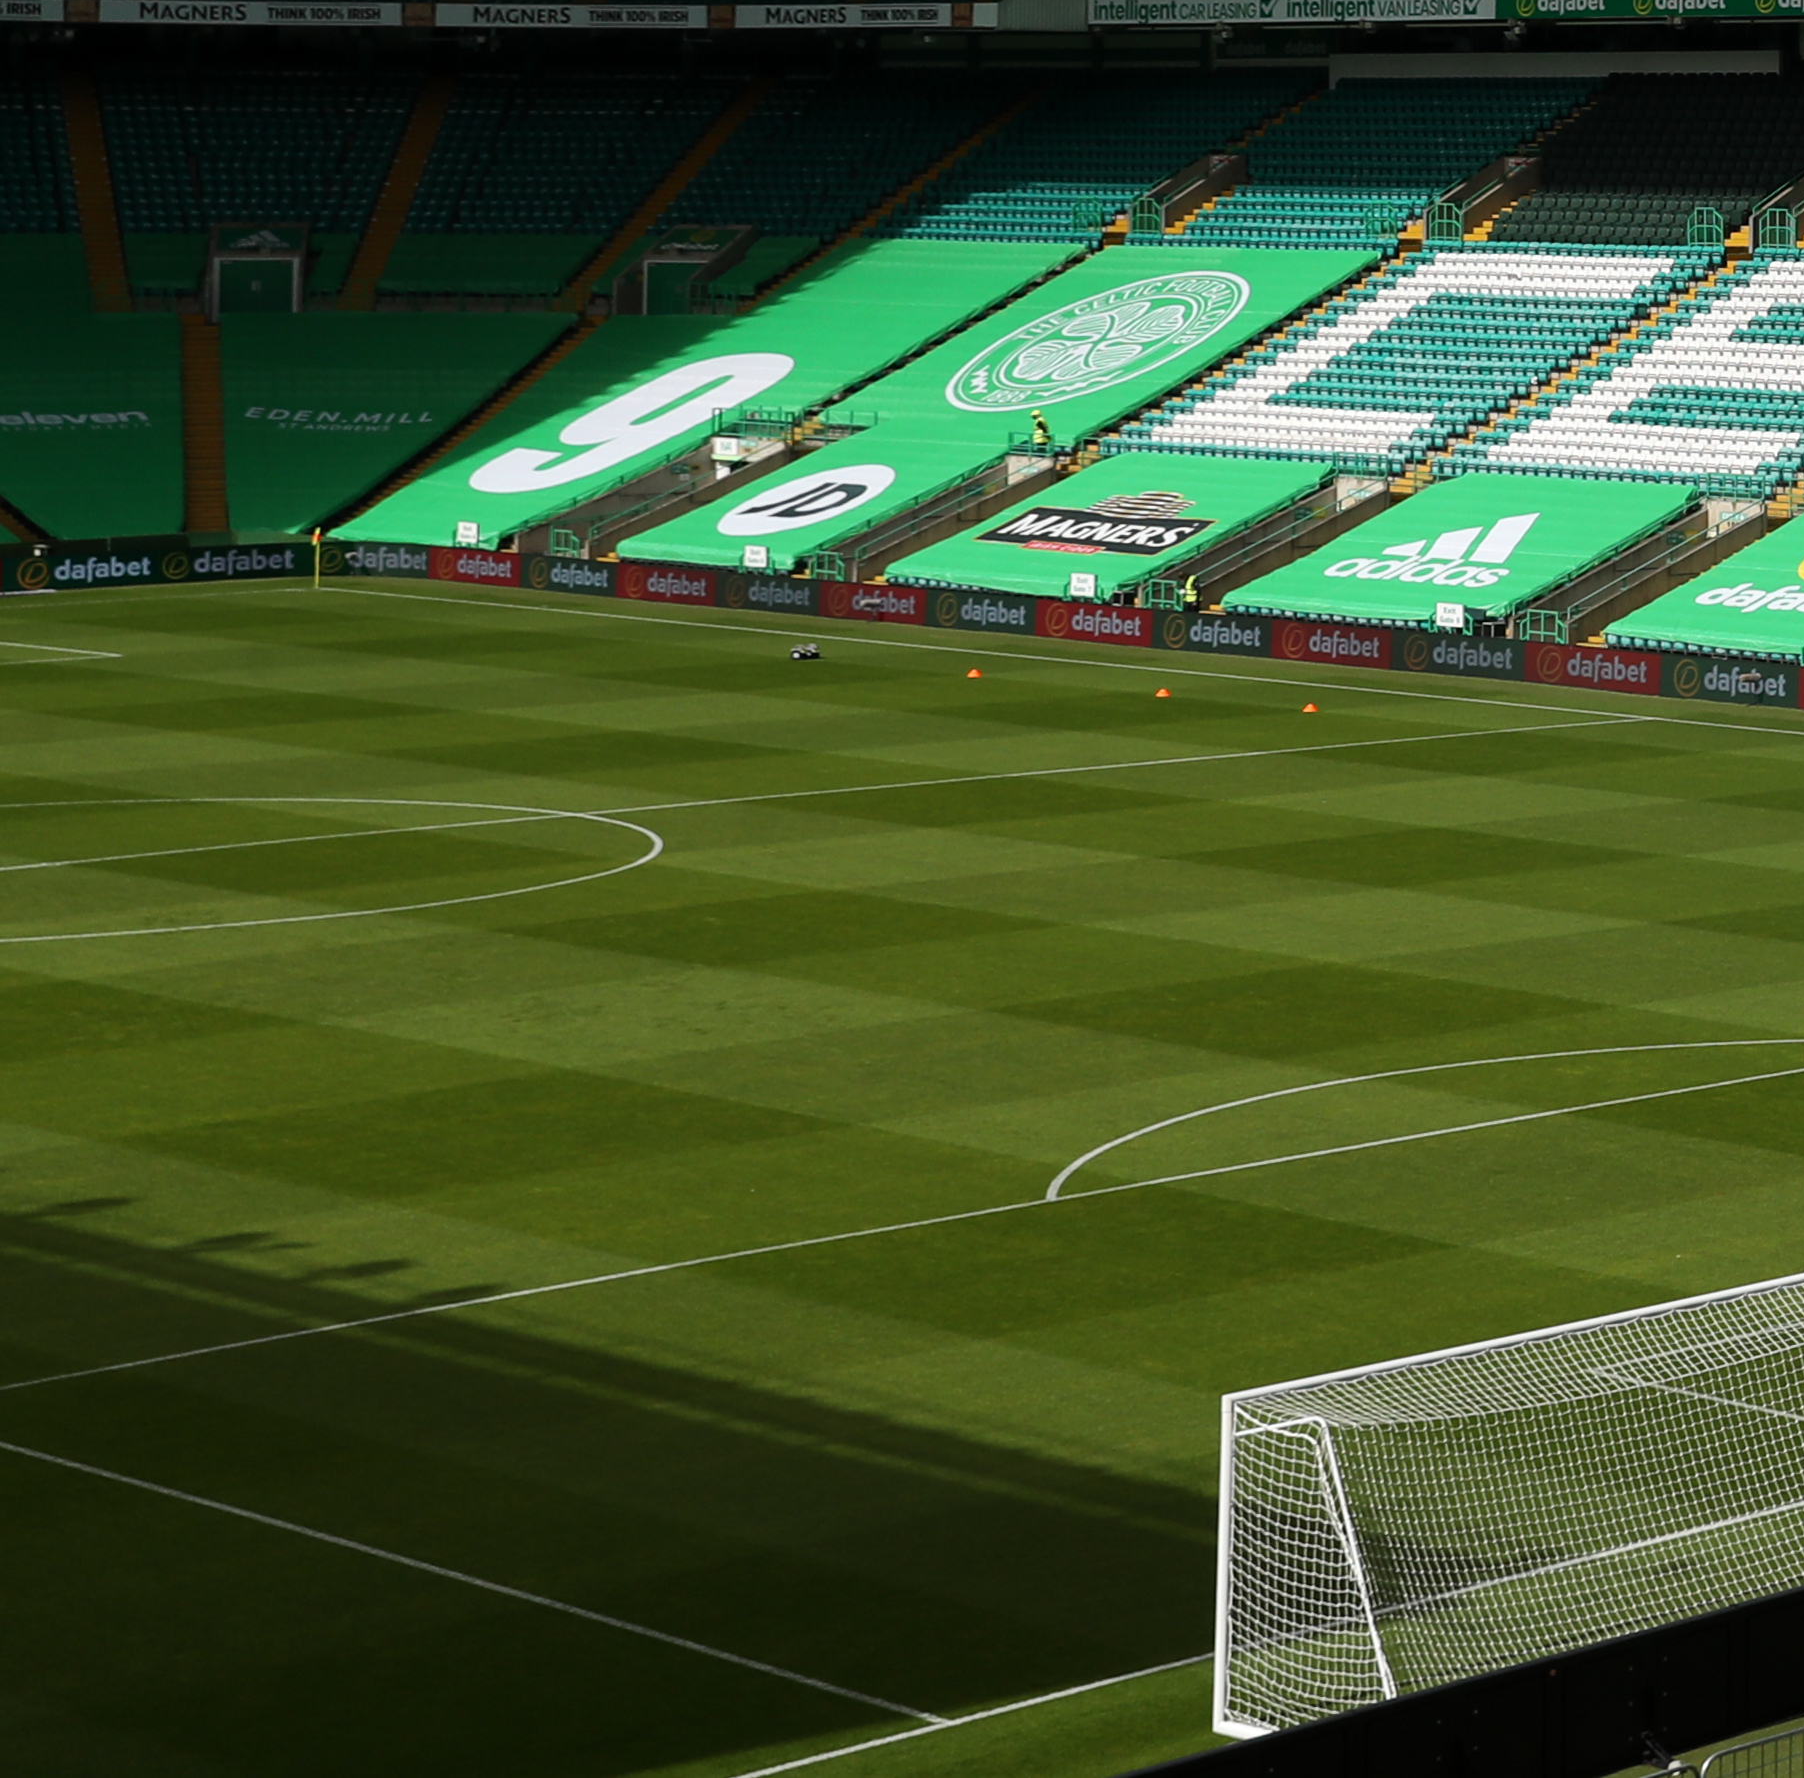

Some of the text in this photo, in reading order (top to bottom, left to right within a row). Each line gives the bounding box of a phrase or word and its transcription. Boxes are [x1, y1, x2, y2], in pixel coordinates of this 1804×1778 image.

[7, 3, 42, 16] IRISH
[140, 3, 382, 21] MAGNERS THINK 100% IRISH
[473, 6, 689, 24] MAGNERS THINK 100% IRISH
[765, 6, 847, 24] MAGNERS
[860, 8, 889, 22] THINK
[1094, 0, 1257, 24] intelligent CAR LEASING
[1378, 1, 1408, 18] VAN
[1409, 0, 1461, 17] LEASING
[469, 353, 795, 493] 9
[735, 482, 868, 518] JD
[997, 513, 1196, 548] MAGNERS
[54, 556, 152, 584] dafabet
[194, 549, 295, 574] dafabet
[351, 546, 428, 572] dafabet
[456, 553, 513, 581] dafabet
[1323, 555, 1510, 589] adidas
[551, 561, 609, 590] dafabet
[646, 570, 707, 599] dafabet
[748, 579, 811, 608] dafabet
[961, 597, 1027, 626] dafabet
[1070, 607, 1142, 639] dafabet
[1190, 618, 1261, 649] dafabet
[1308, 628, 1380, 660] dafabet
[1433, 637, 1512, 669] dafabet
[1566, 651, 1647, 684] dafabet
